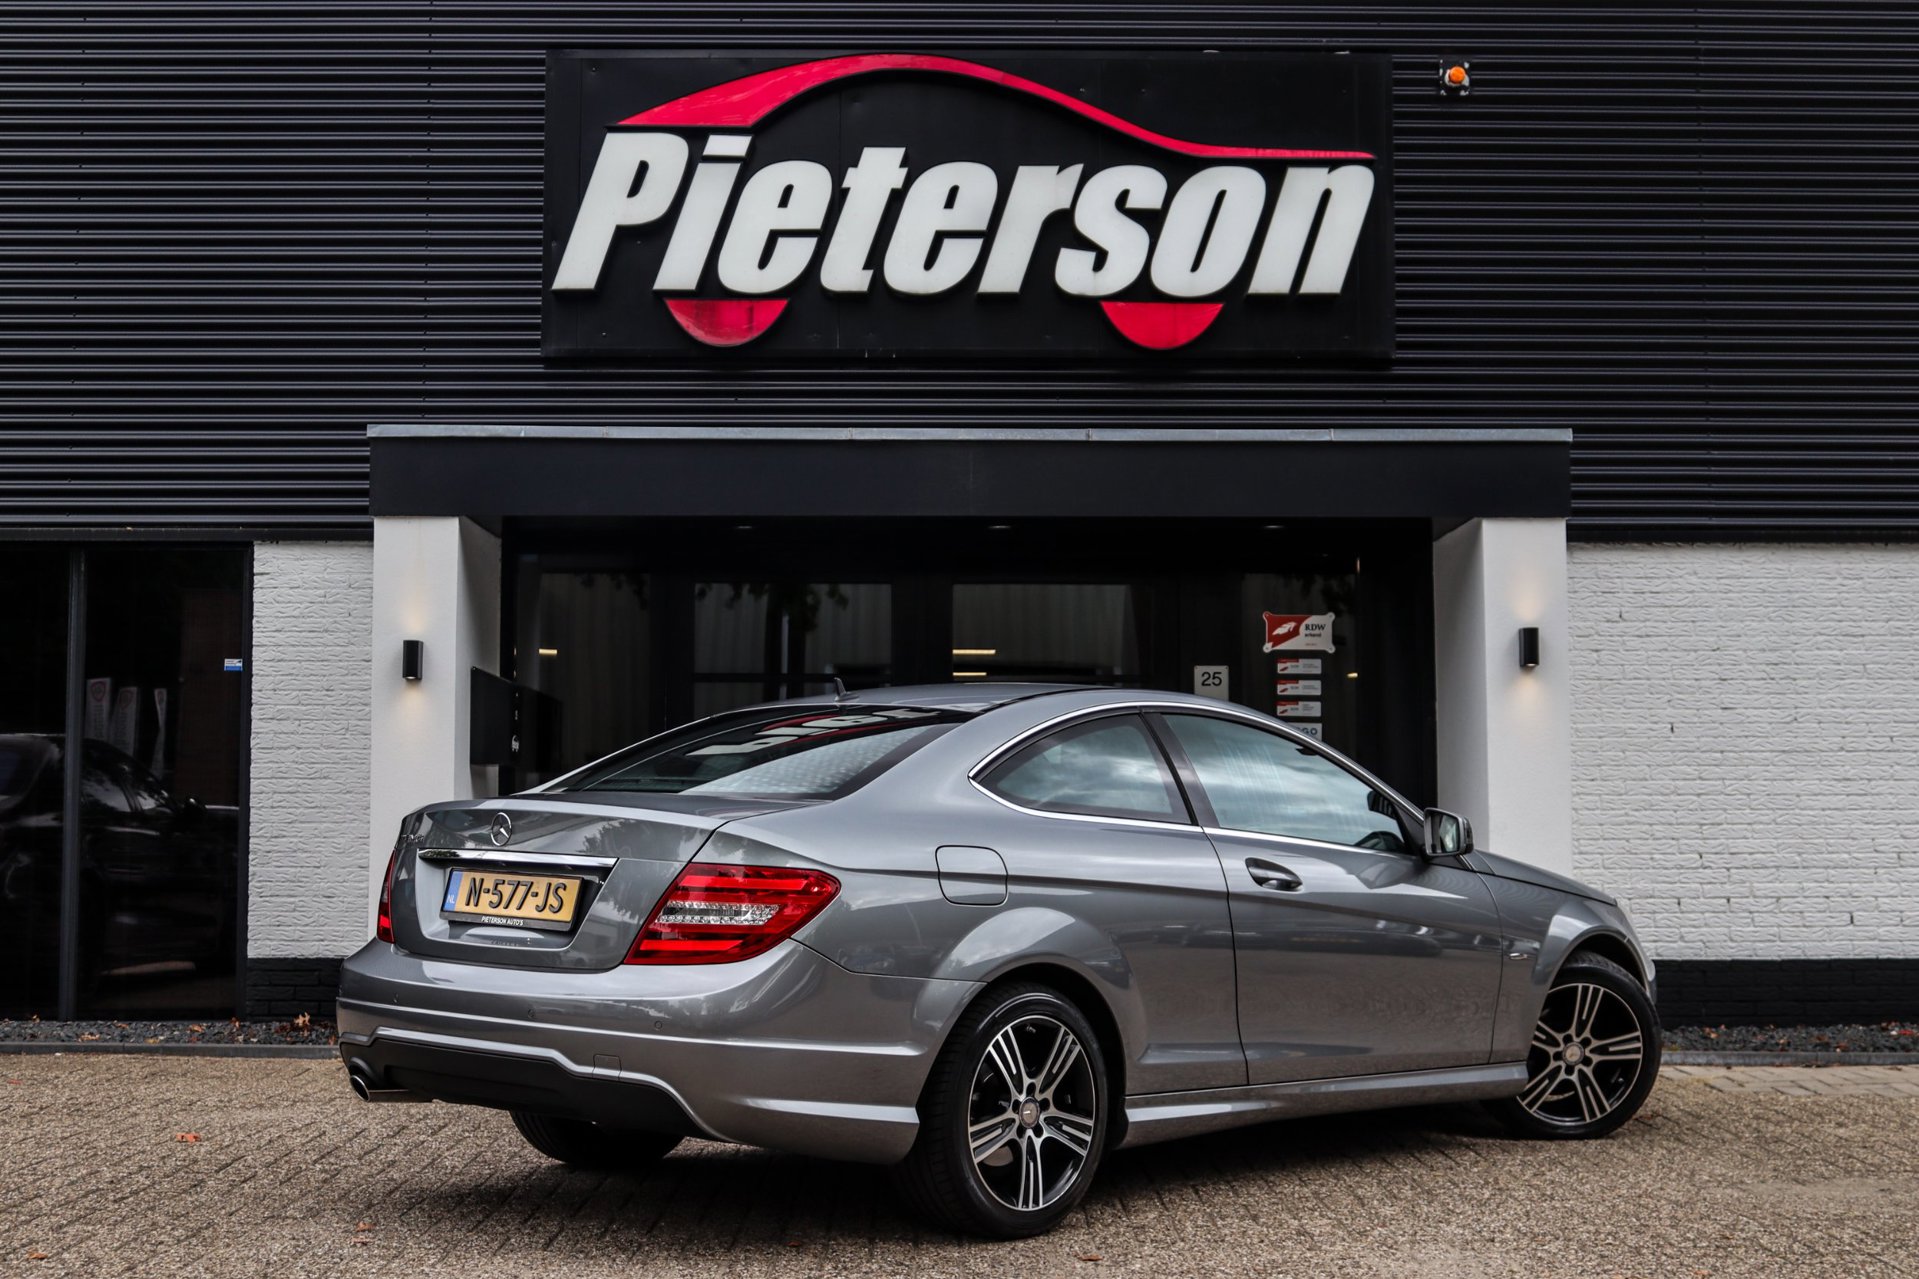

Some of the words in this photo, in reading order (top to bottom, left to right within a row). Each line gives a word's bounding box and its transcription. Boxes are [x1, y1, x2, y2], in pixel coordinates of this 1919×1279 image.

[550, 131, 1376, 297] Pieterson
[1201, 671, 1222, 687] 25
[446, 894, 456, 904] NL
[464, 877, 568, 914] N-577-JS
[481, 915, 507, 924] PIETERSON
